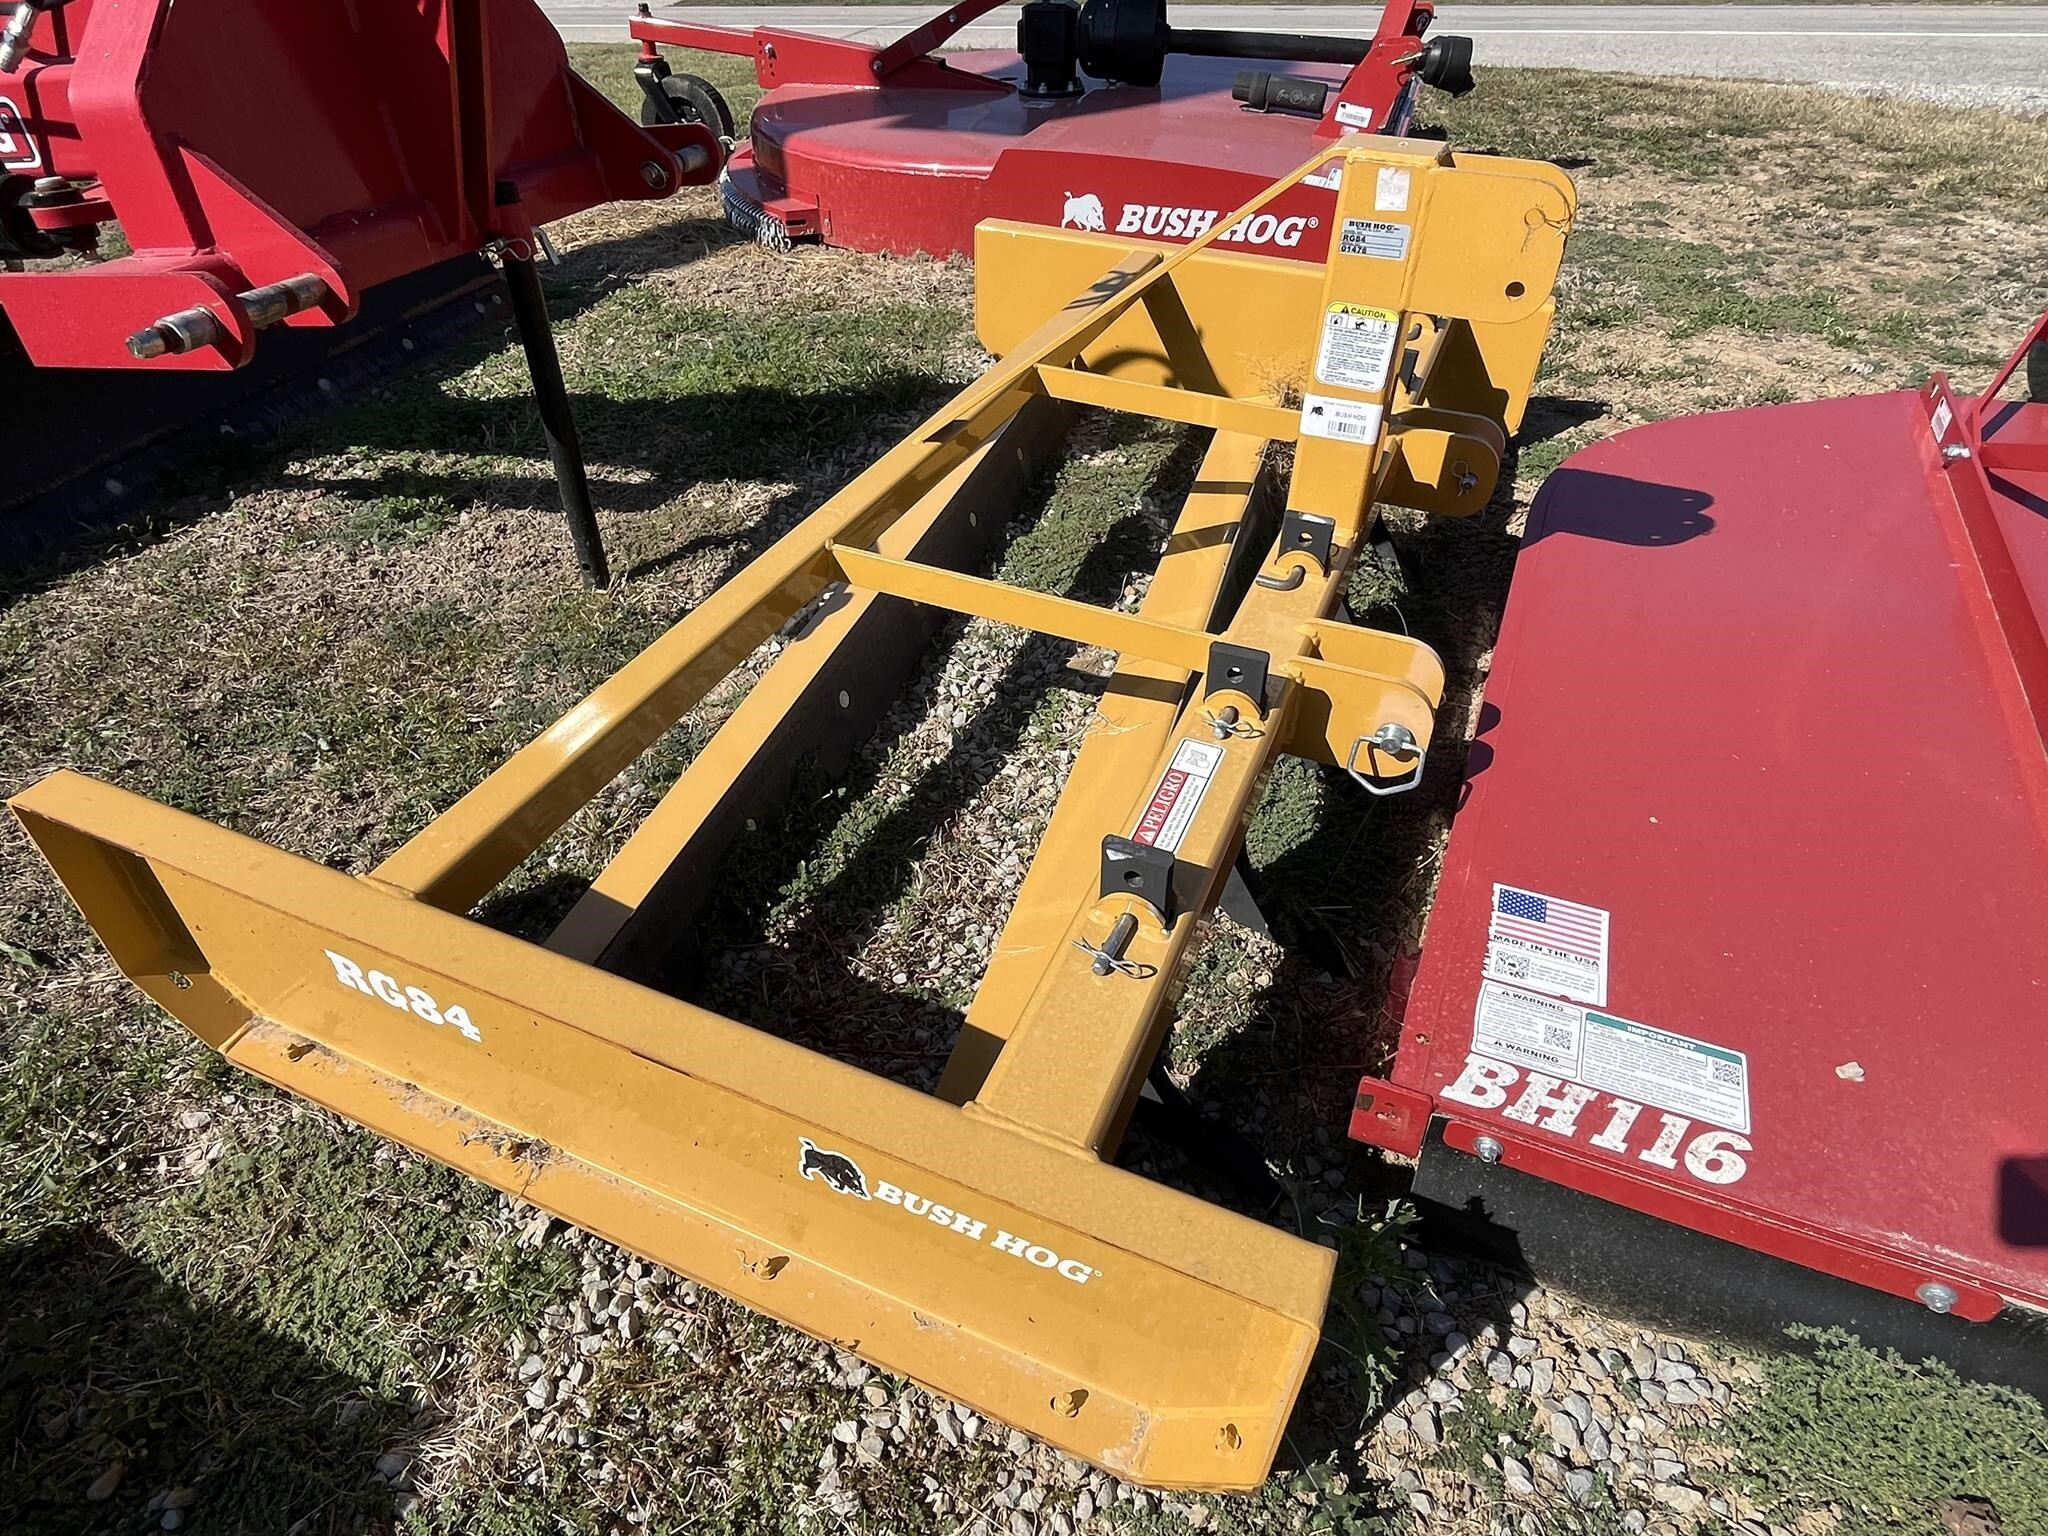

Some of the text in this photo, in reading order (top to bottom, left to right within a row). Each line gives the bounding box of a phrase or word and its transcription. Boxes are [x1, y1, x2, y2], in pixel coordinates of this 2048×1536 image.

[1115, 204, 1306, 247] BUSH HOG
[1349, 221, 1372, 230] BUSH
[1373, 223, 1394, 231] HOG
[1350, 307, 1387, 319] CAUTION
[1144, 771, 1184, 832] PELIGRO
[1493, 935, 1526, 948] MADE
[1547, 948, 1571, 959] THE
[1574, 956, 1599, 967] USA
[323, 948, 483, 1043] RG84
[1512, 992, 1564, 1012] WARNING
[1505, 1042, 1559, 1063] WARNING
[1627, 1025, 1697, 1051] IMPORTANT
[1439, 1052, 1753, 1185] BH116
[873, 1180, 1093, 1284] BUSH HOG
